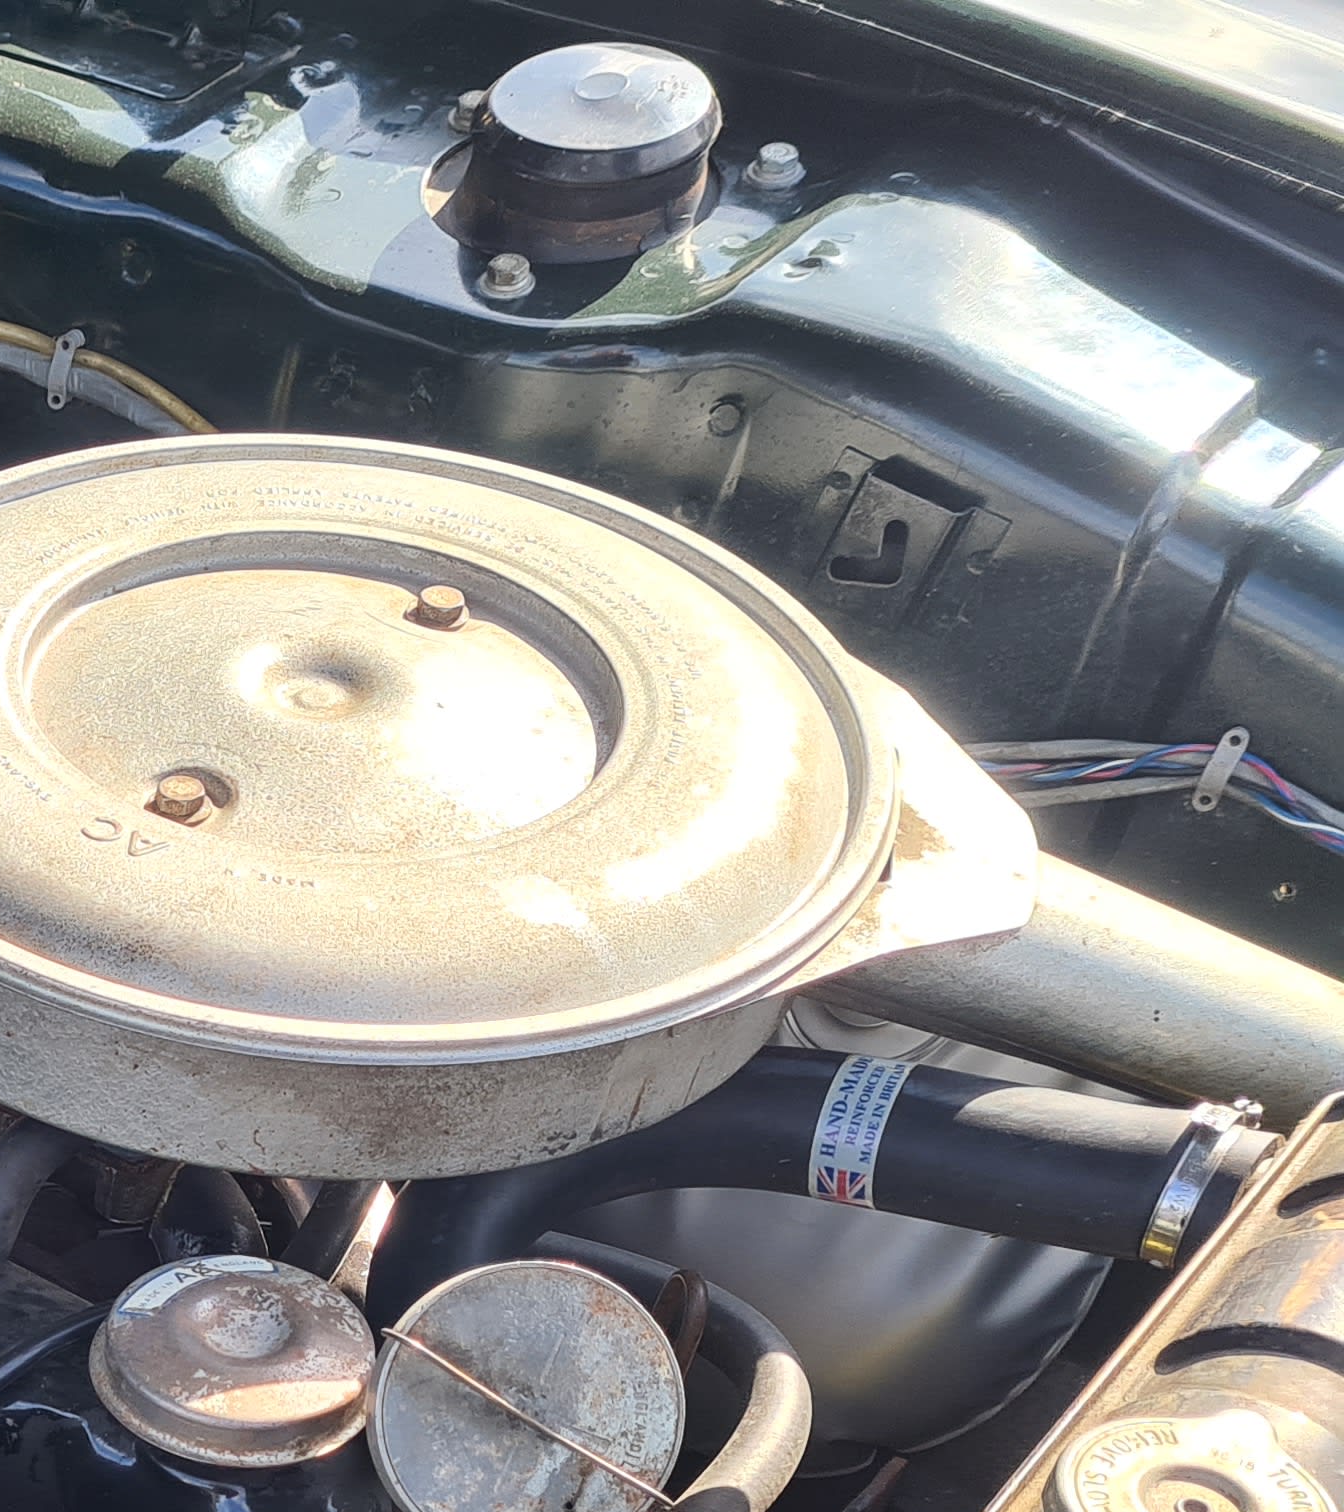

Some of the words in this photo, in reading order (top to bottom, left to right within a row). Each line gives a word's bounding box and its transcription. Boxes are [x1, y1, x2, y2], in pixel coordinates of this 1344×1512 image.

[80, 816, 171, 857] AC
[843, 1065, 886, 1146] REINFORCED
[858, 1121, 881, 1166] MADE
[871, 1102, 887, 1119] IN
